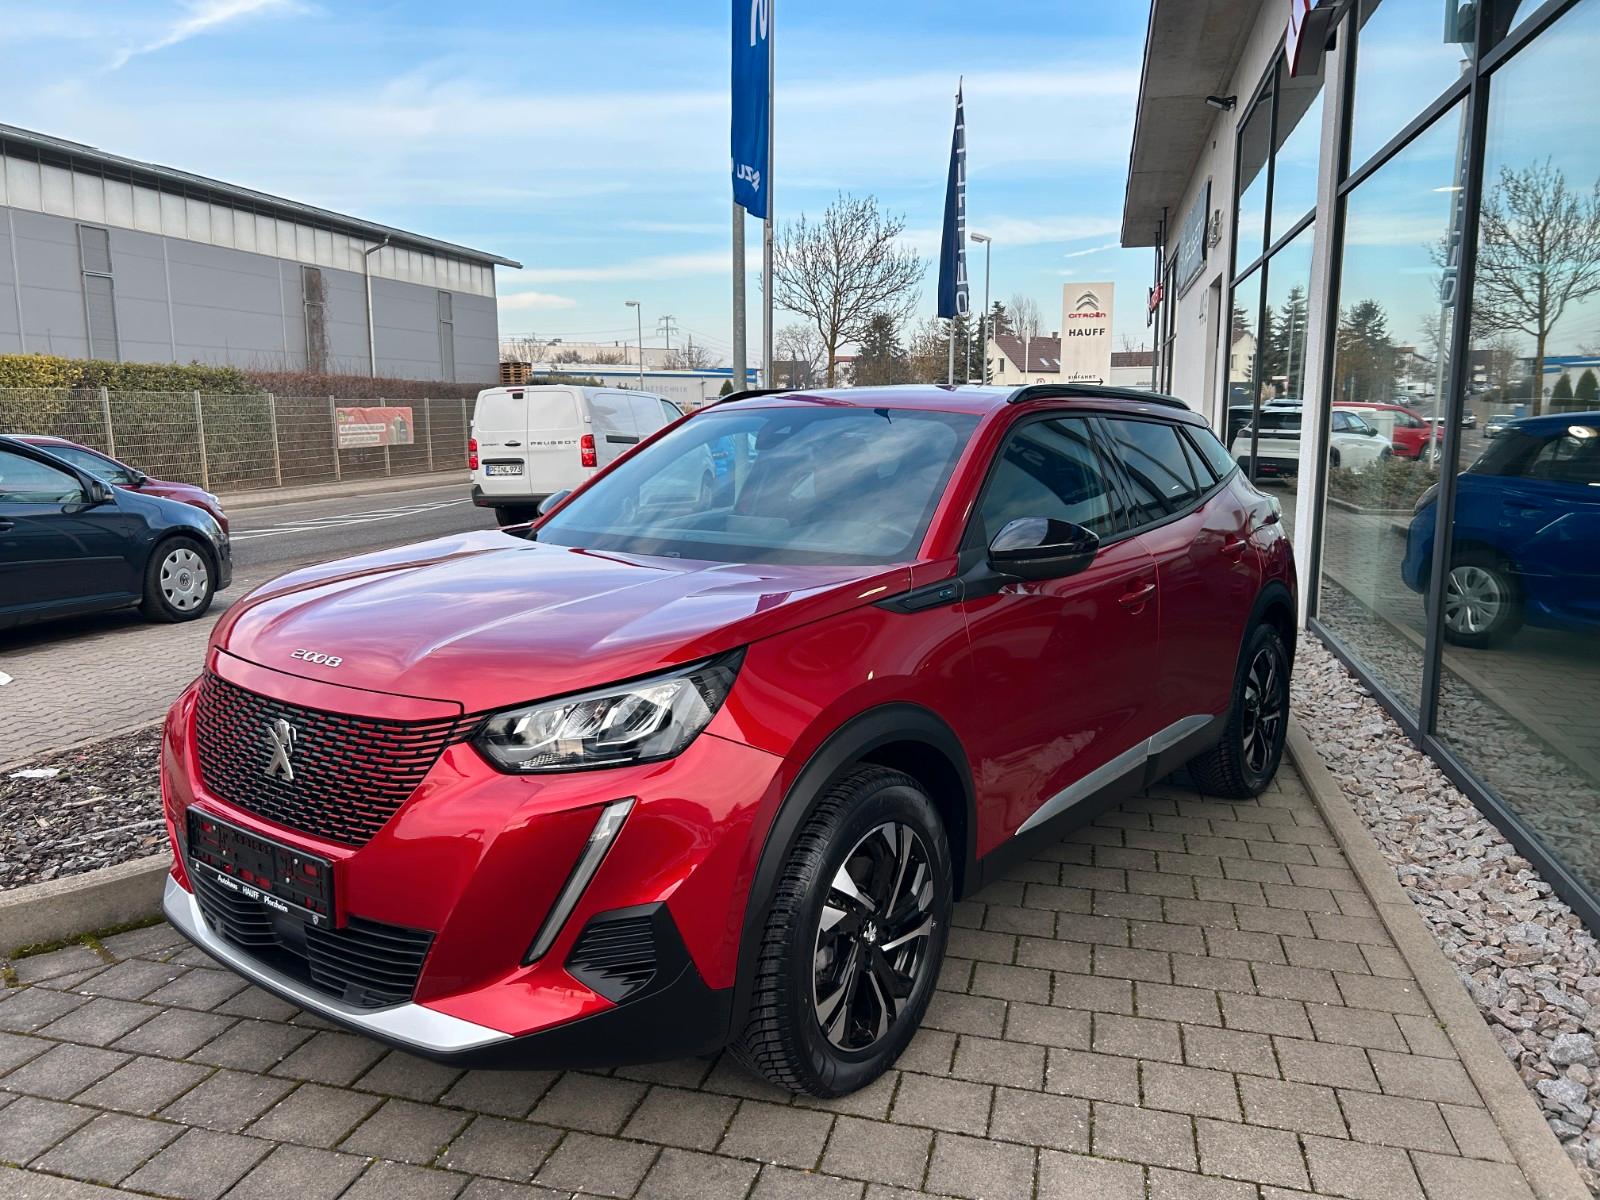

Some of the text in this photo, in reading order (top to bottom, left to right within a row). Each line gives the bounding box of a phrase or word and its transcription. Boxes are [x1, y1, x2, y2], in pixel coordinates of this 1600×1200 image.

[1068, 328, 1106, 337] HAUFF
[290, 648, 343, 668] 2008
[217, 874, 238, 891] Autohaus
[242, 886, 260, 900] HAUFF
